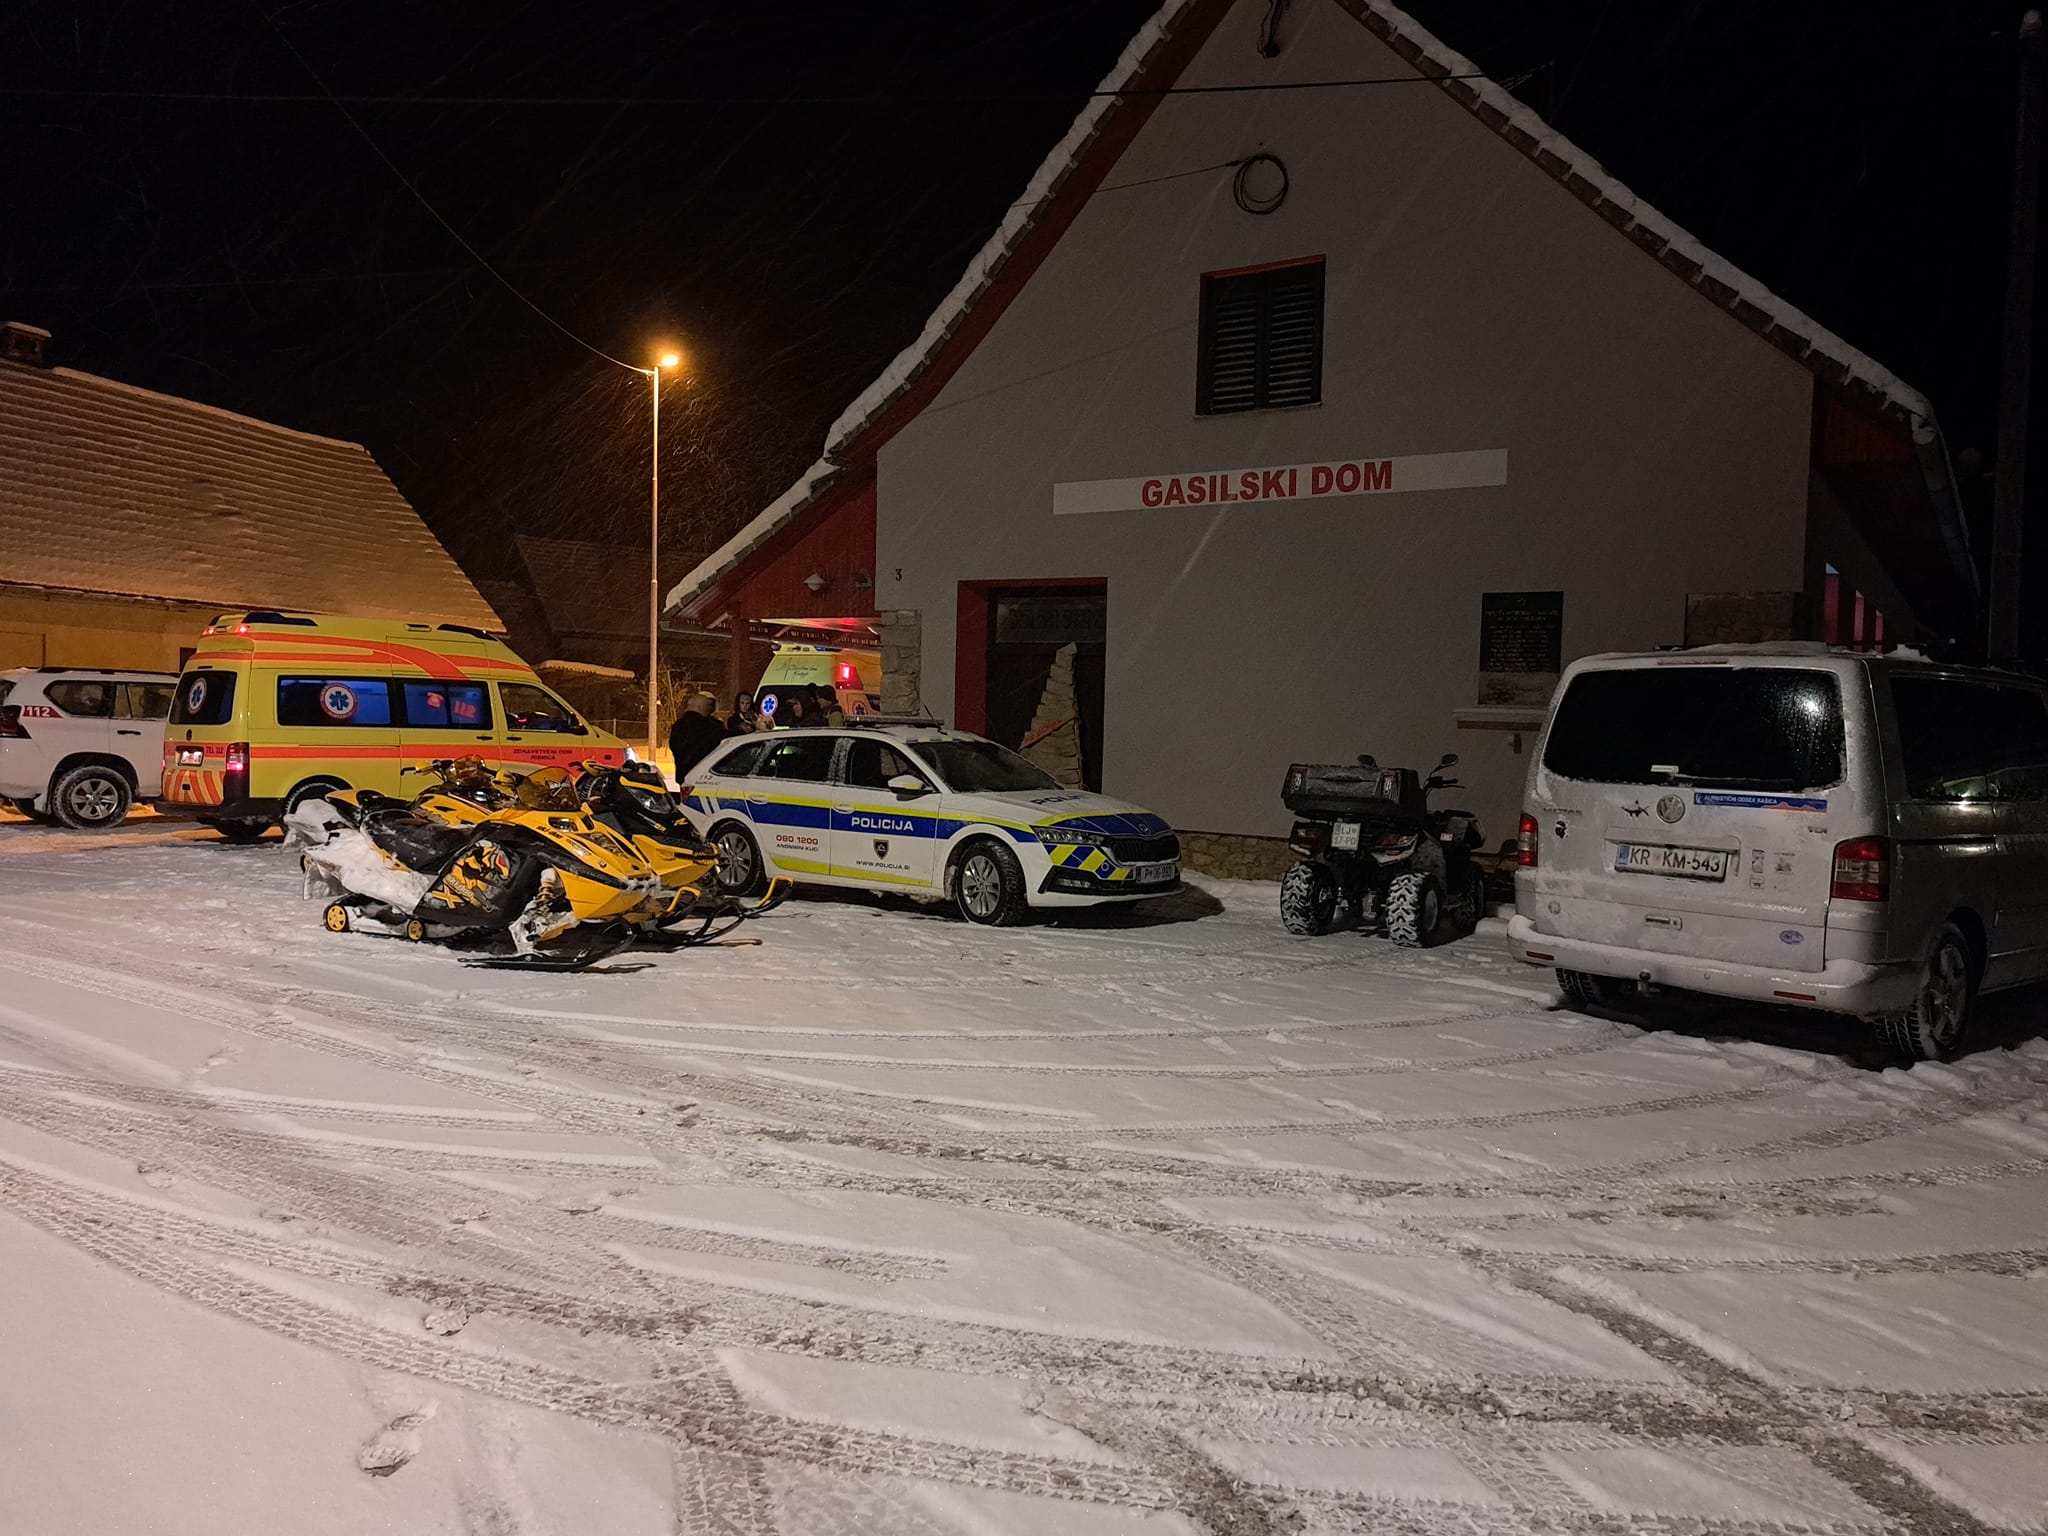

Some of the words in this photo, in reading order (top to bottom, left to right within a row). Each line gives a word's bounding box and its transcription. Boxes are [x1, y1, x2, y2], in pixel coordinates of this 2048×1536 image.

[1142, 468, 1297, 507] GASILSKI
[1311, 460, 1392, 495] DOM
[895, 568, 903, 582] 3
[26, 706, 51, 717] 112
[851, 816, 914, 833] POLICIJA
[797, 836, 819, 845] 1200
[1630, 847, 1650, 865] KR
[1662, 851, 1720, 873] KM-543
